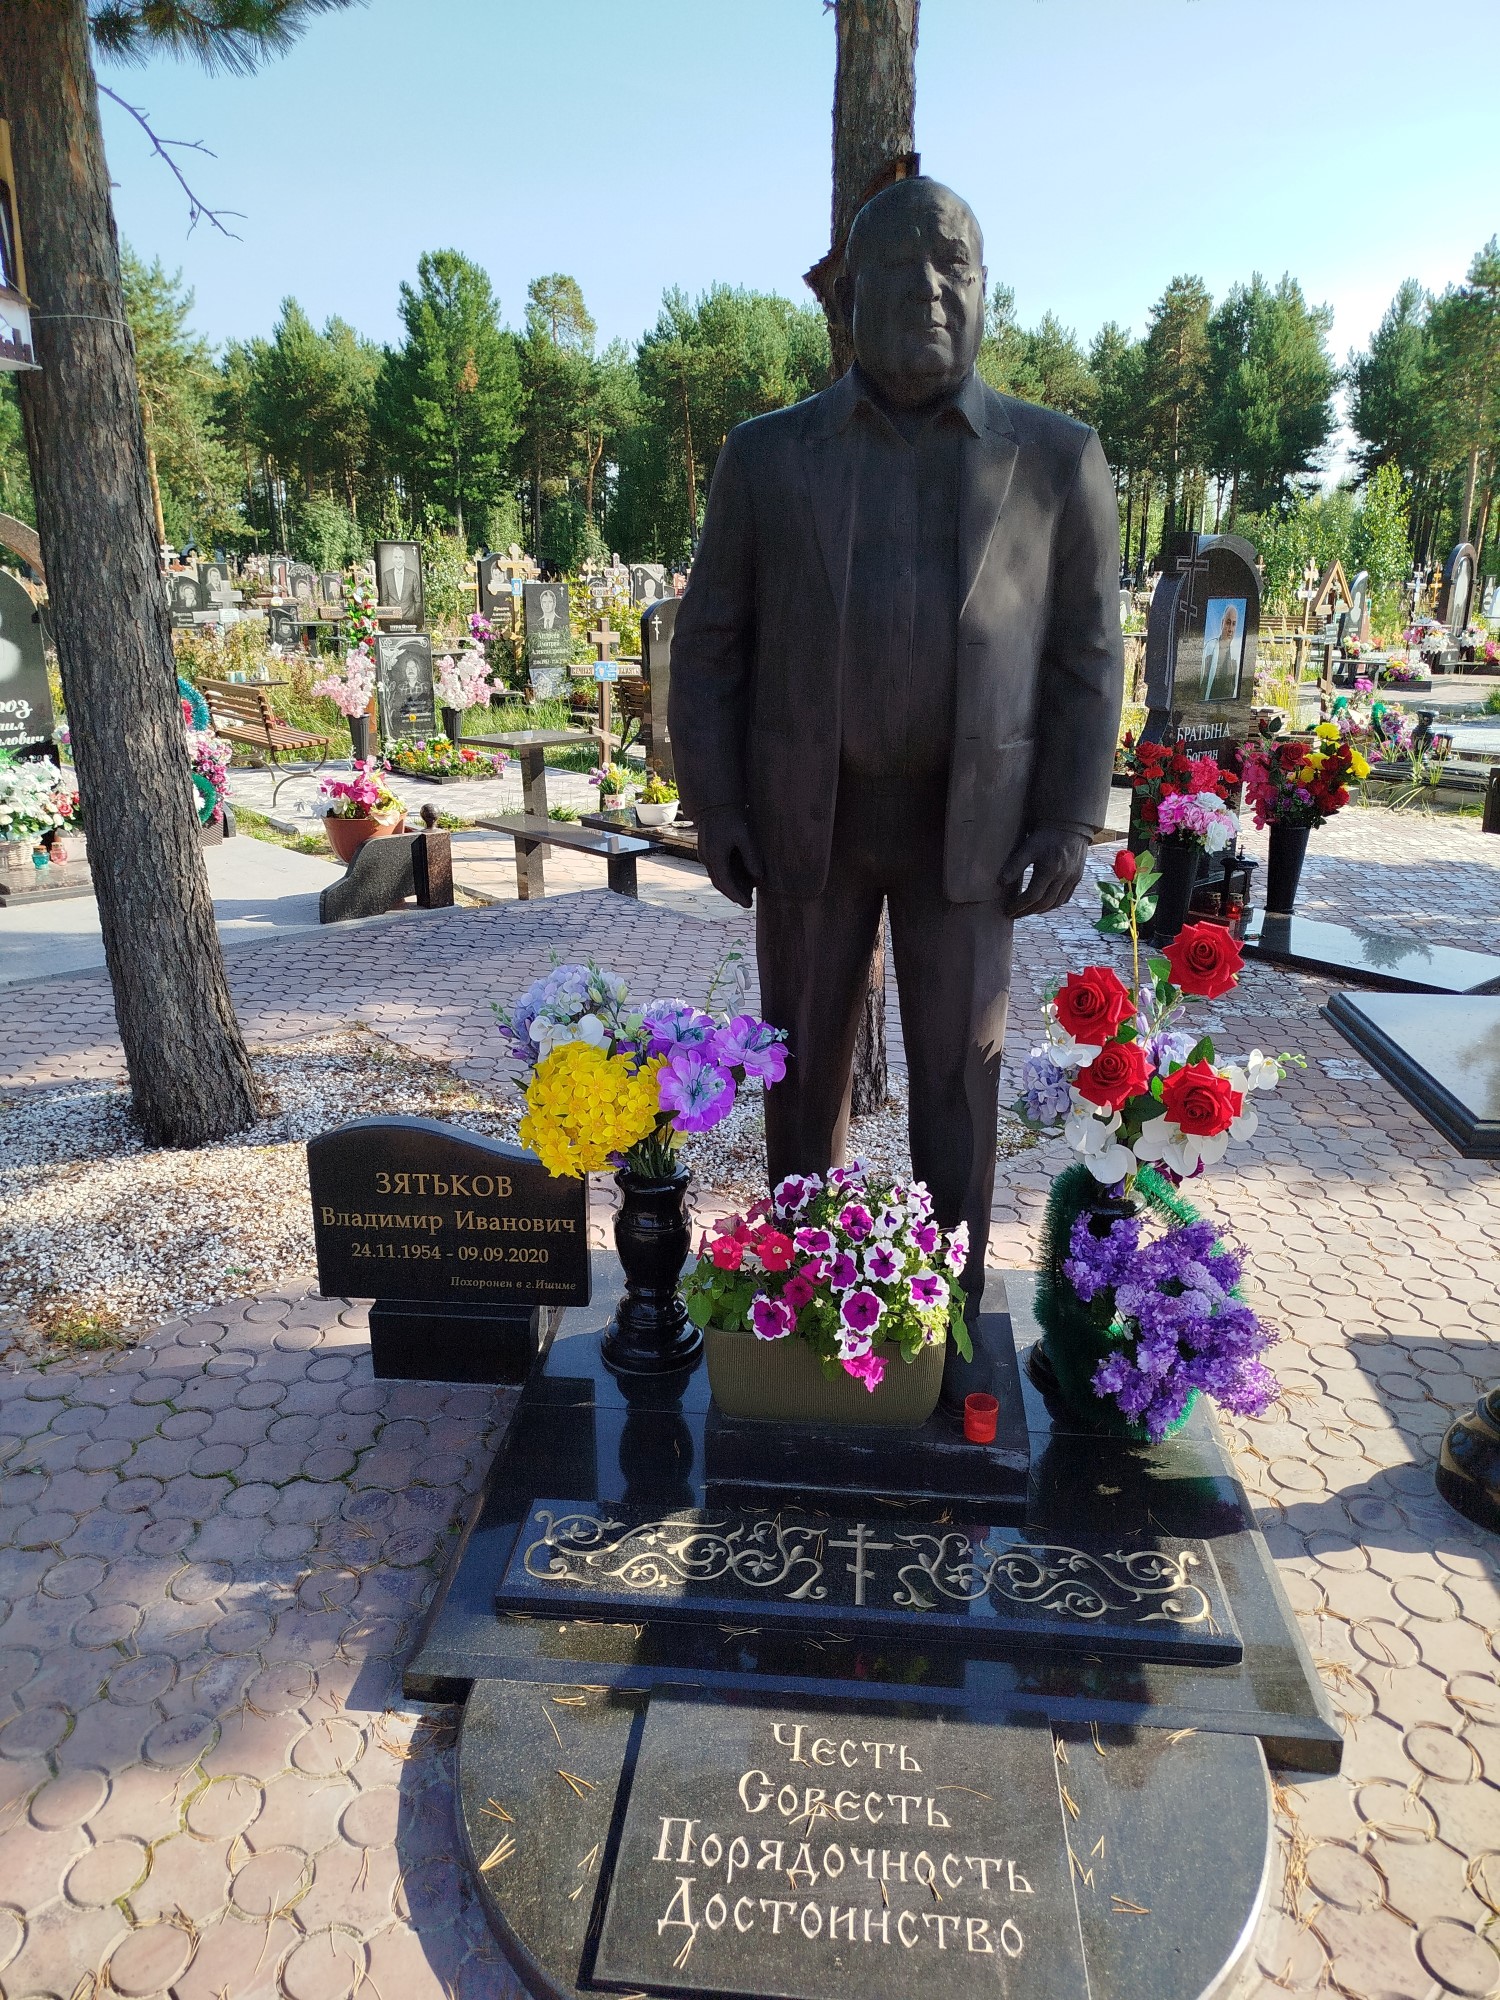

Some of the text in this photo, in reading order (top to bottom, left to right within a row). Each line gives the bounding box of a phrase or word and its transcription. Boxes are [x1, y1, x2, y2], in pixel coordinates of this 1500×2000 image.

[1176, 722, 1230, 742] БРАТЫНА
[375, 1172, 513, 1198] ЗЯТЬКОВ
[320, 1206, 576, 1235] Владимир Иванович
[351, 1243, 441, 1260] 24.11.1954
[458, 1246, 549, 1264] 09.09.2020
[450, 1276, 513, 1289] Похоронен
[525, 1280, 576, 1290] г.Ишиме
